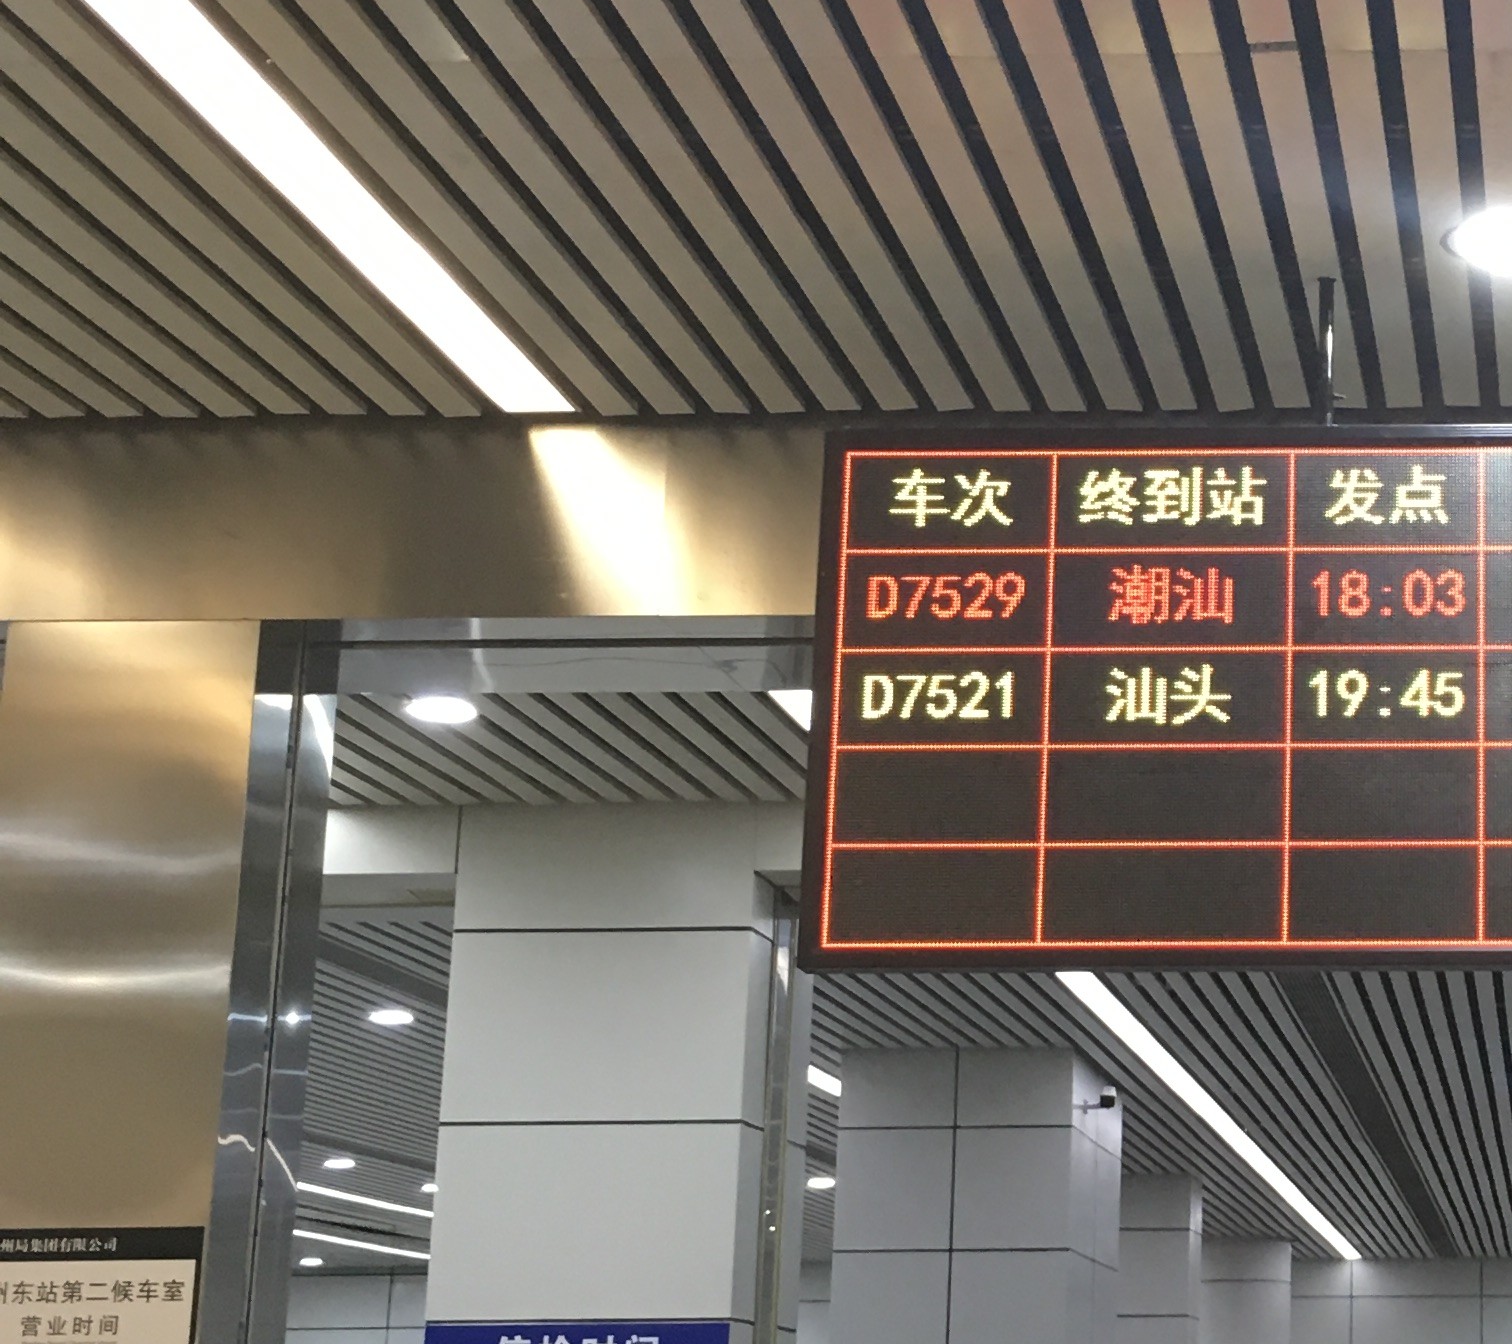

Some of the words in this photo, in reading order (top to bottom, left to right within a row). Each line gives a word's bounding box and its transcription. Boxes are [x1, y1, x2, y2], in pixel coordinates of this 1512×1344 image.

[889, 468, 1014, 528] 车次
[1078, 466, 1268, 526] 终到站
[1324, 464, 1450, 526] 发点
[866, 571, 1026, 619] D7529
[1107, 564, 1234, 625] 潮汕
[1311, 568, 1467, 618] 18:03
[861, 671, 1015, 720] D7521
[1105, 663, 1232, 725] 汕头
[1308, 668, 1466, 718] 19:45
[20, 1314, 120, 1337] 营业时间
